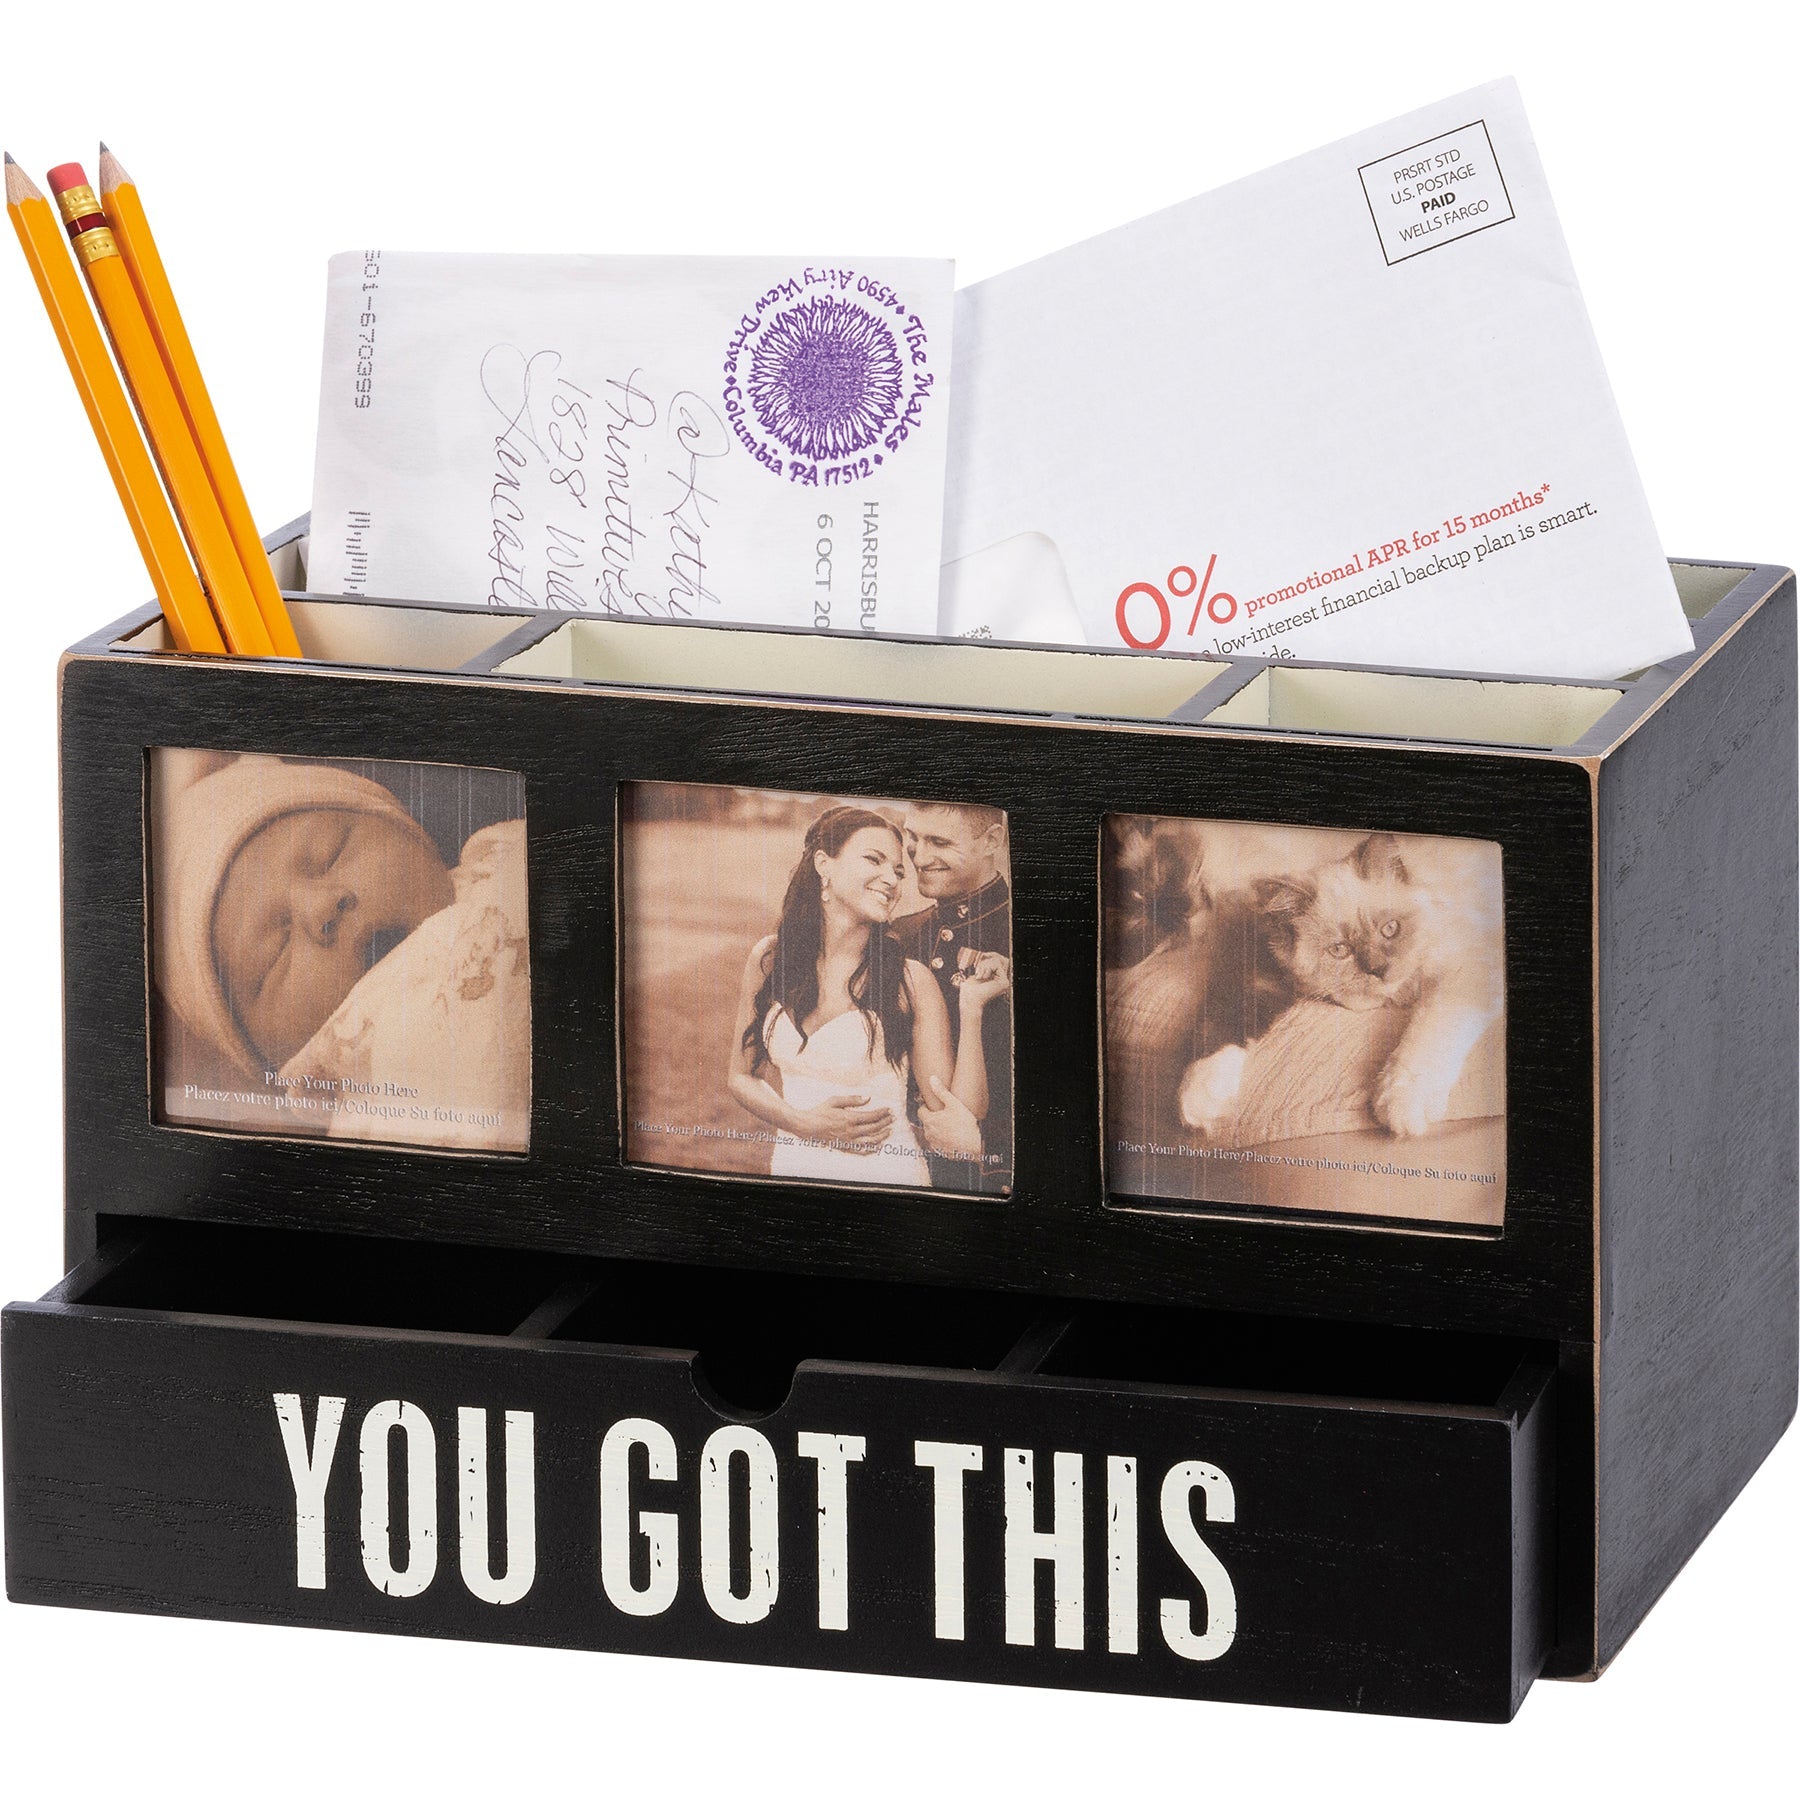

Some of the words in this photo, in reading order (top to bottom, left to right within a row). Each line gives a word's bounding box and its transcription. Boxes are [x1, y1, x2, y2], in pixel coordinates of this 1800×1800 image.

[1390, 188, 1415, 205] U.S.
[1416, 163, 1476, 195] POSTAGE
[1393, 159, 1432, 184] PRSRT
[1434, 149, 1461, 168] STD
[1398, 216, 1443, 242] WELLS
[1443, 199, 1489, 225] FARGO
[1420, 192, 1456, 214] PAID
[755, 278, 804, 314] View
[803, 267, 855, 290] Airy
[857, 276, 898, 307] 4590
[723, 314, 761, 374] Drive
[902, 314, 928, 367] The
[884, 373, 934, 452] Males
[549, 378, 592, 508] 1828
[722, 386, 784, 476] Columbia
[789, 461, 818, 487] PA
[824, 457, 874, 487] 17512
[817, 514, 834, 530] 6
[815, 538, 833, 592] OCT
[860, 502, 879, 632] HARRISBU
[1116, 554, 1237, 650] 0%
[1244, 554, 1363, 618] promotional
[1367, 538, 1411, 569] APR
[1412, 531, 1440, 551] for
[1443, 516, 1467, 539] 15
[1213, 605, 1320, 655] low-interest
[1321, 571, 1401, 616] financial
[1401, 555, 1471, 585] backup
[1474, 533, 1516, 562] plan
[1518, 524, 1535, 541] is
[1538, 501, 1598, 533] smart.
[184, 1084, 230, 1102] Placez
[233, 1092, 271, 1105] votre
[275, 1094, 317, 1111] photo
[410, 1106, 430, 1121] Su
[434, 1107, 463, 1123] foto
[264, 1071, 300, 1088] Place
[303, 1074, 338, 1091] Your
[341, 1078, 380, 1094] Photo
[384, 1083, 419, 1098] Here
[634, 1120, 663, 1133] Place
[664, 1123, 690, 1136] Your
[693, 1126, 724, 1138] Photo
[1118, 1141, 1146, 1153] Place
[1148, 1143, 1174, 1155] Your
[1178, 1145, 1211, 1158] Photo
[1284, 1157, 1314, 1168] votre
[1316, 1157, 1350, 1171] photo
[1424, 1167, 1440, 1179] Su
[1443, 1168, 1467, 1180] foto
[273, 1393, 536, 1606] YOU
[600, 1417, 866, 1631] GOT
[915, 1440, 1239, 1662] THIS
